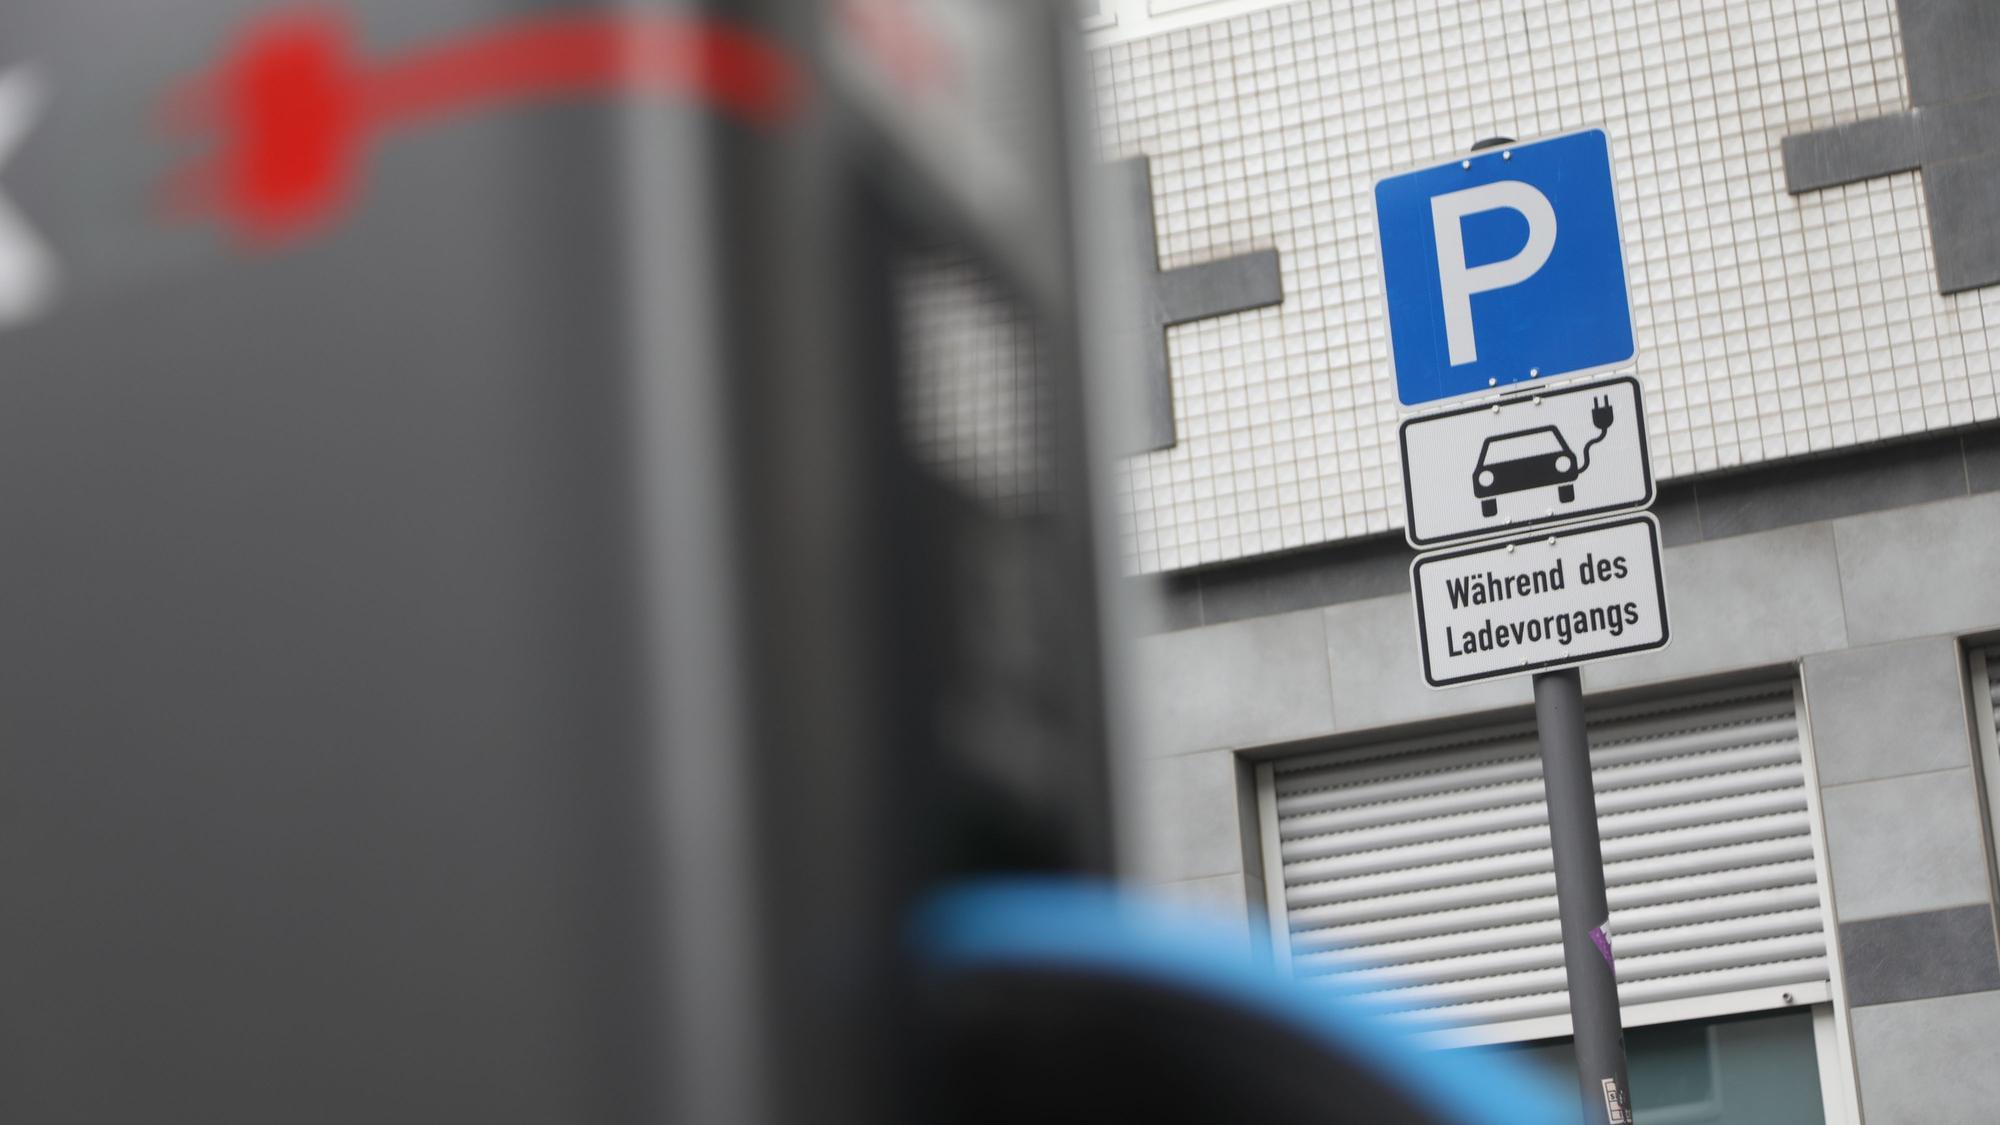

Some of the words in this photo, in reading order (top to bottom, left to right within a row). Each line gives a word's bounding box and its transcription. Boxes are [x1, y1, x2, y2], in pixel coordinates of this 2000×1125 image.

[1430, 180, 1557, 367] P
[1446, 558, 1565, 610] Während
[1579, 552, 1628, 586] des
[1446, 601, 1639, 658] Ladevorgangs
